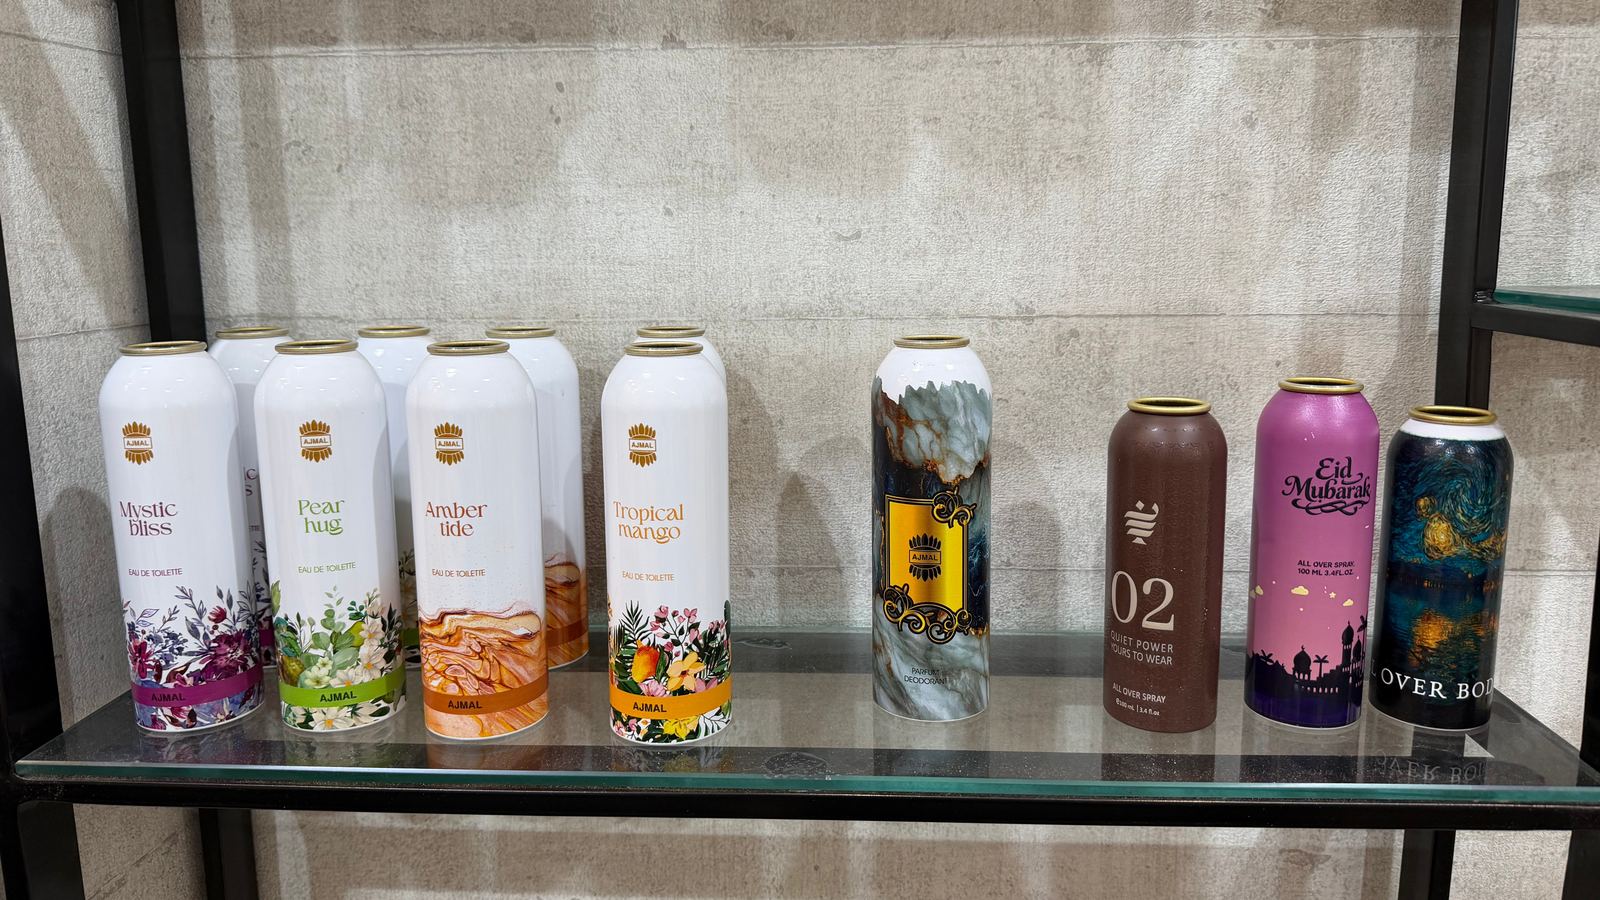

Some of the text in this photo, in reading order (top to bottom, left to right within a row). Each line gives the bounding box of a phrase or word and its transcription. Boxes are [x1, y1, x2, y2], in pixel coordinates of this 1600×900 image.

[1315, 456, 1363, 485] Eid
[1282, 476, 1371, 516] Mubarak
[119, 501, 178, 521] Mystic
[298, 499, 345, 516] Pear
[425, 501, 488, 519] Amber
[612, 501, 684, 525] Tropical
[129, 519, 173, 536] bliss
[304, 517, 344, 536] hug
[440, 520, 475, 537] tide
[618, 523, 681, 544] mango
[912, 553, 938, 561] AJMAL
[152, 568, 183, 576] TOILETTE
[298, 562, 356, 574] EAU DE TOILETTE
[432, 568, 444, 576] EAU
[456, 569, 486, 578] TOILETTE
[622, 571, 634, 580] EAU
[645, 573, 675, 582] TOILETTE
[1111, 570, 1175, 631] 02
[1110, 630, 1174, 654] QUIET POWER
[1110, 642, 1173, 666] YOURS TO WEAR
[904, 674, 948, 685] DEODORANT
[912, 667, 940, 676] PARFUM
[1380, 667, 1447, 700] OVER
[151, 692, 186, 702] AJMAL
[319, 690, 358, 703] AJMAL
[1112, 682, 1166, 704] ALL OVER SPRAY
[447, 700, 483, 710] AJMAL
[632, 701, 667, 713] AJMAL
